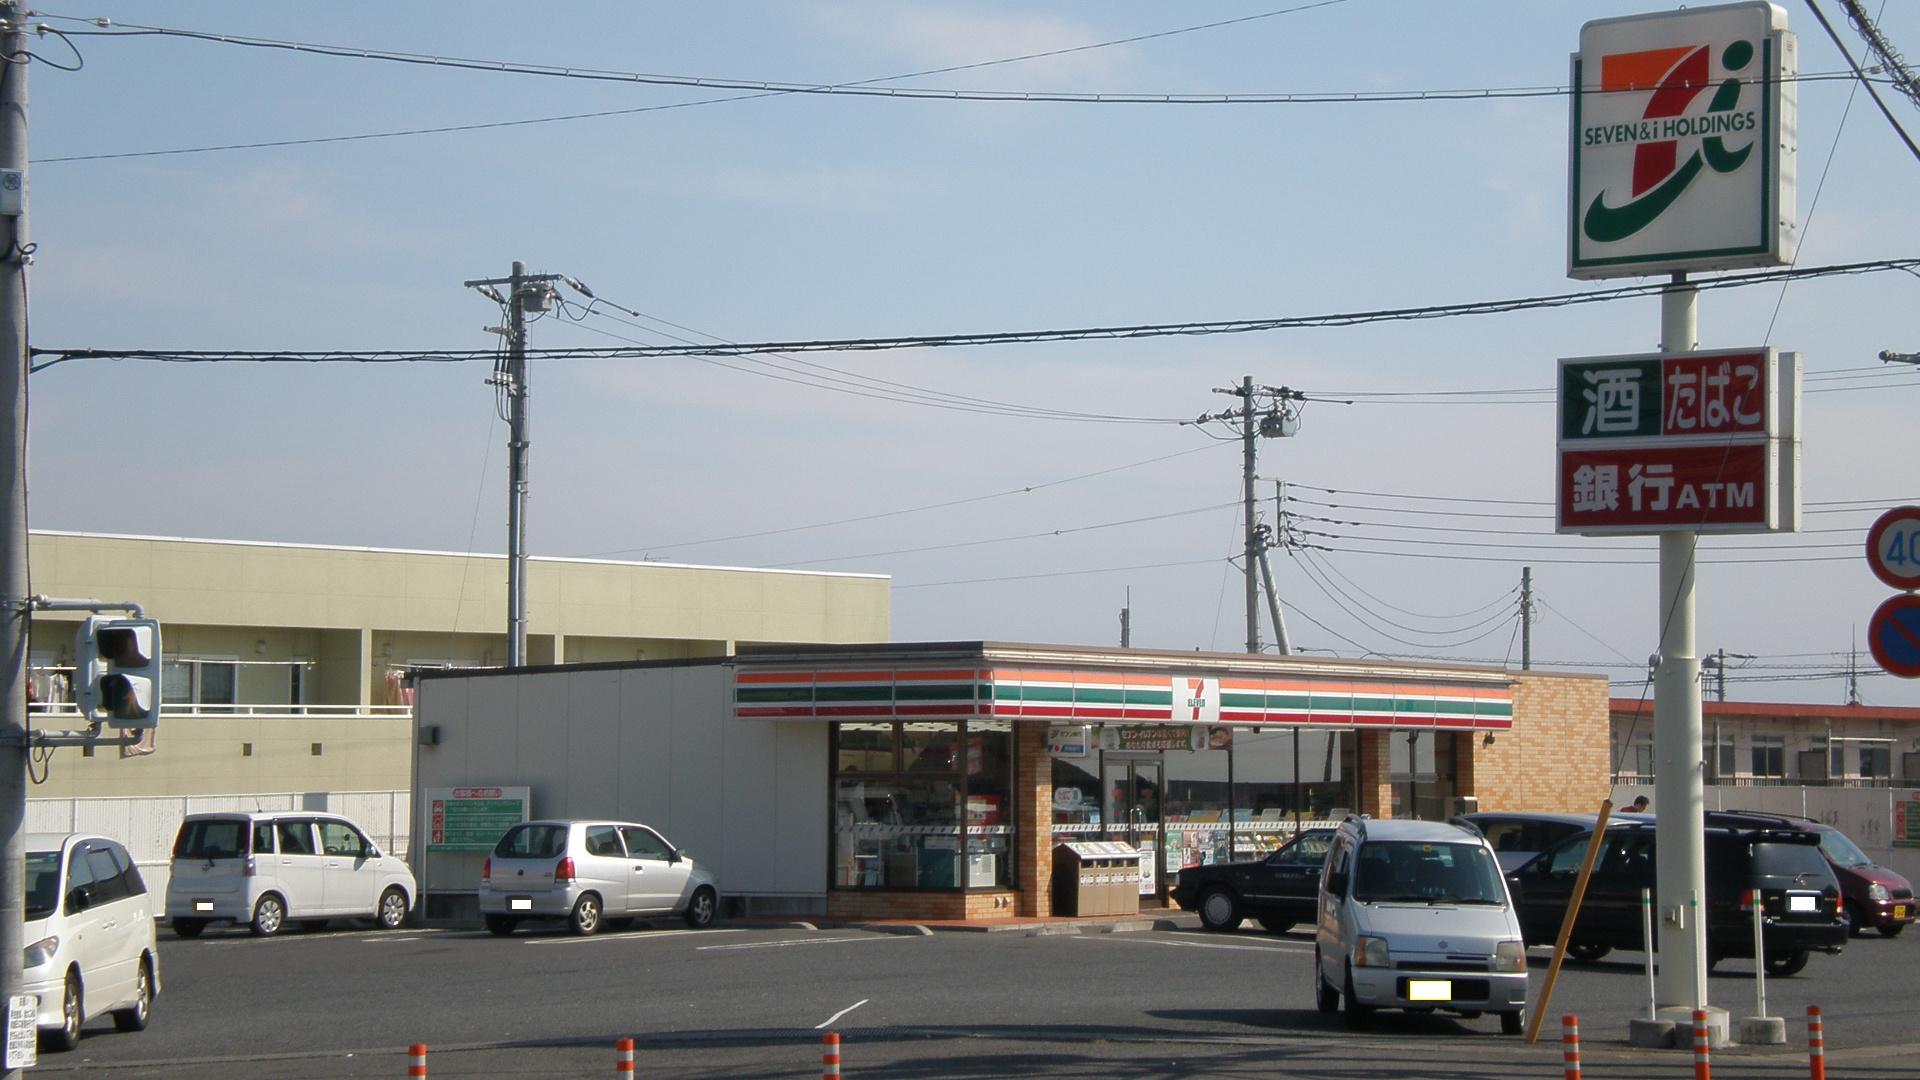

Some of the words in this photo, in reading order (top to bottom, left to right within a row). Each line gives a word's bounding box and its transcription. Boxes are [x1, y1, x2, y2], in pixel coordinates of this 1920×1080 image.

[1663, 111, 1755, 137] HOLDINGS
[1582, 368, 1642, 435] 酒
[1667, 361, 1761, 430] たばこ
